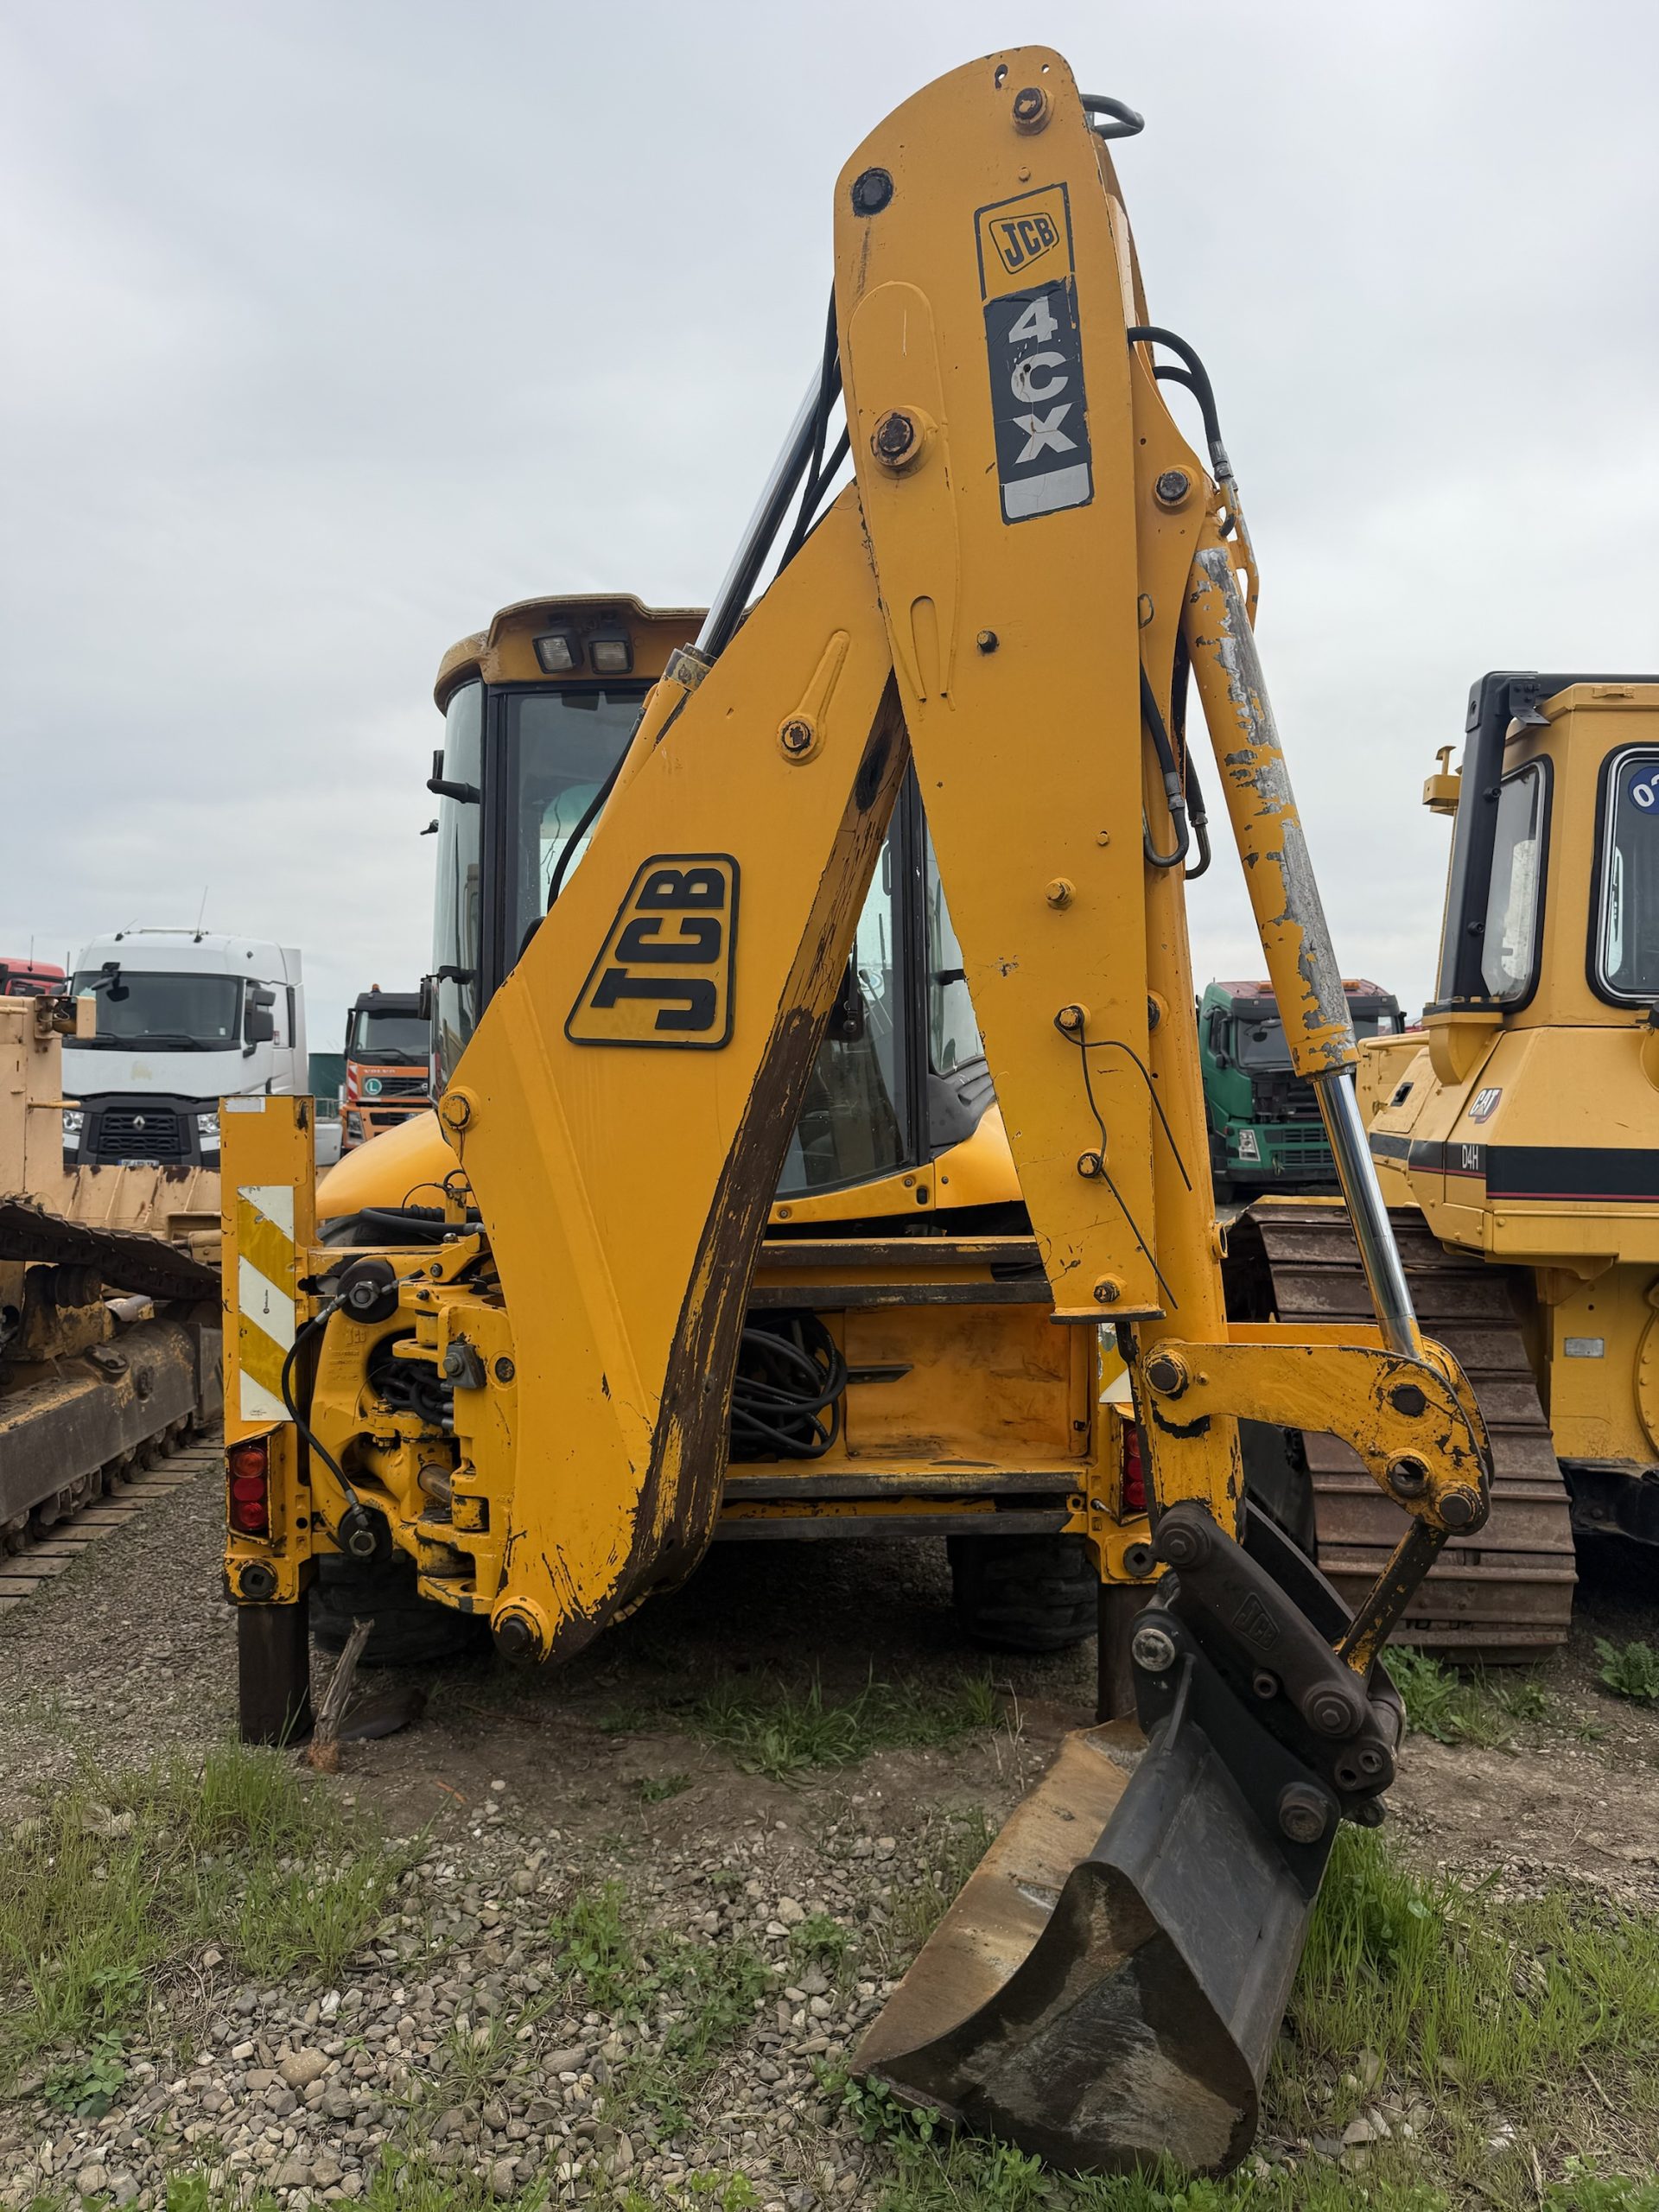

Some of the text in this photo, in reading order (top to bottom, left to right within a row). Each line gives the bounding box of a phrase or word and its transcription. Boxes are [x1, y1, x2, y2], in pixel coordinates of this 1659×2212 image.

[1001, 218, 1055, 267] JCB
[1007, 296, 1078, 467] 4CX
[590, 868, 725, 1031] JCB
[369, 1081, 378, 1092] L
[1469, 1089, 1501, 1116] CAT
[1461, 1144, 1479, 1171] D4H
[1234, 1600, 1276, 1648] JCB
